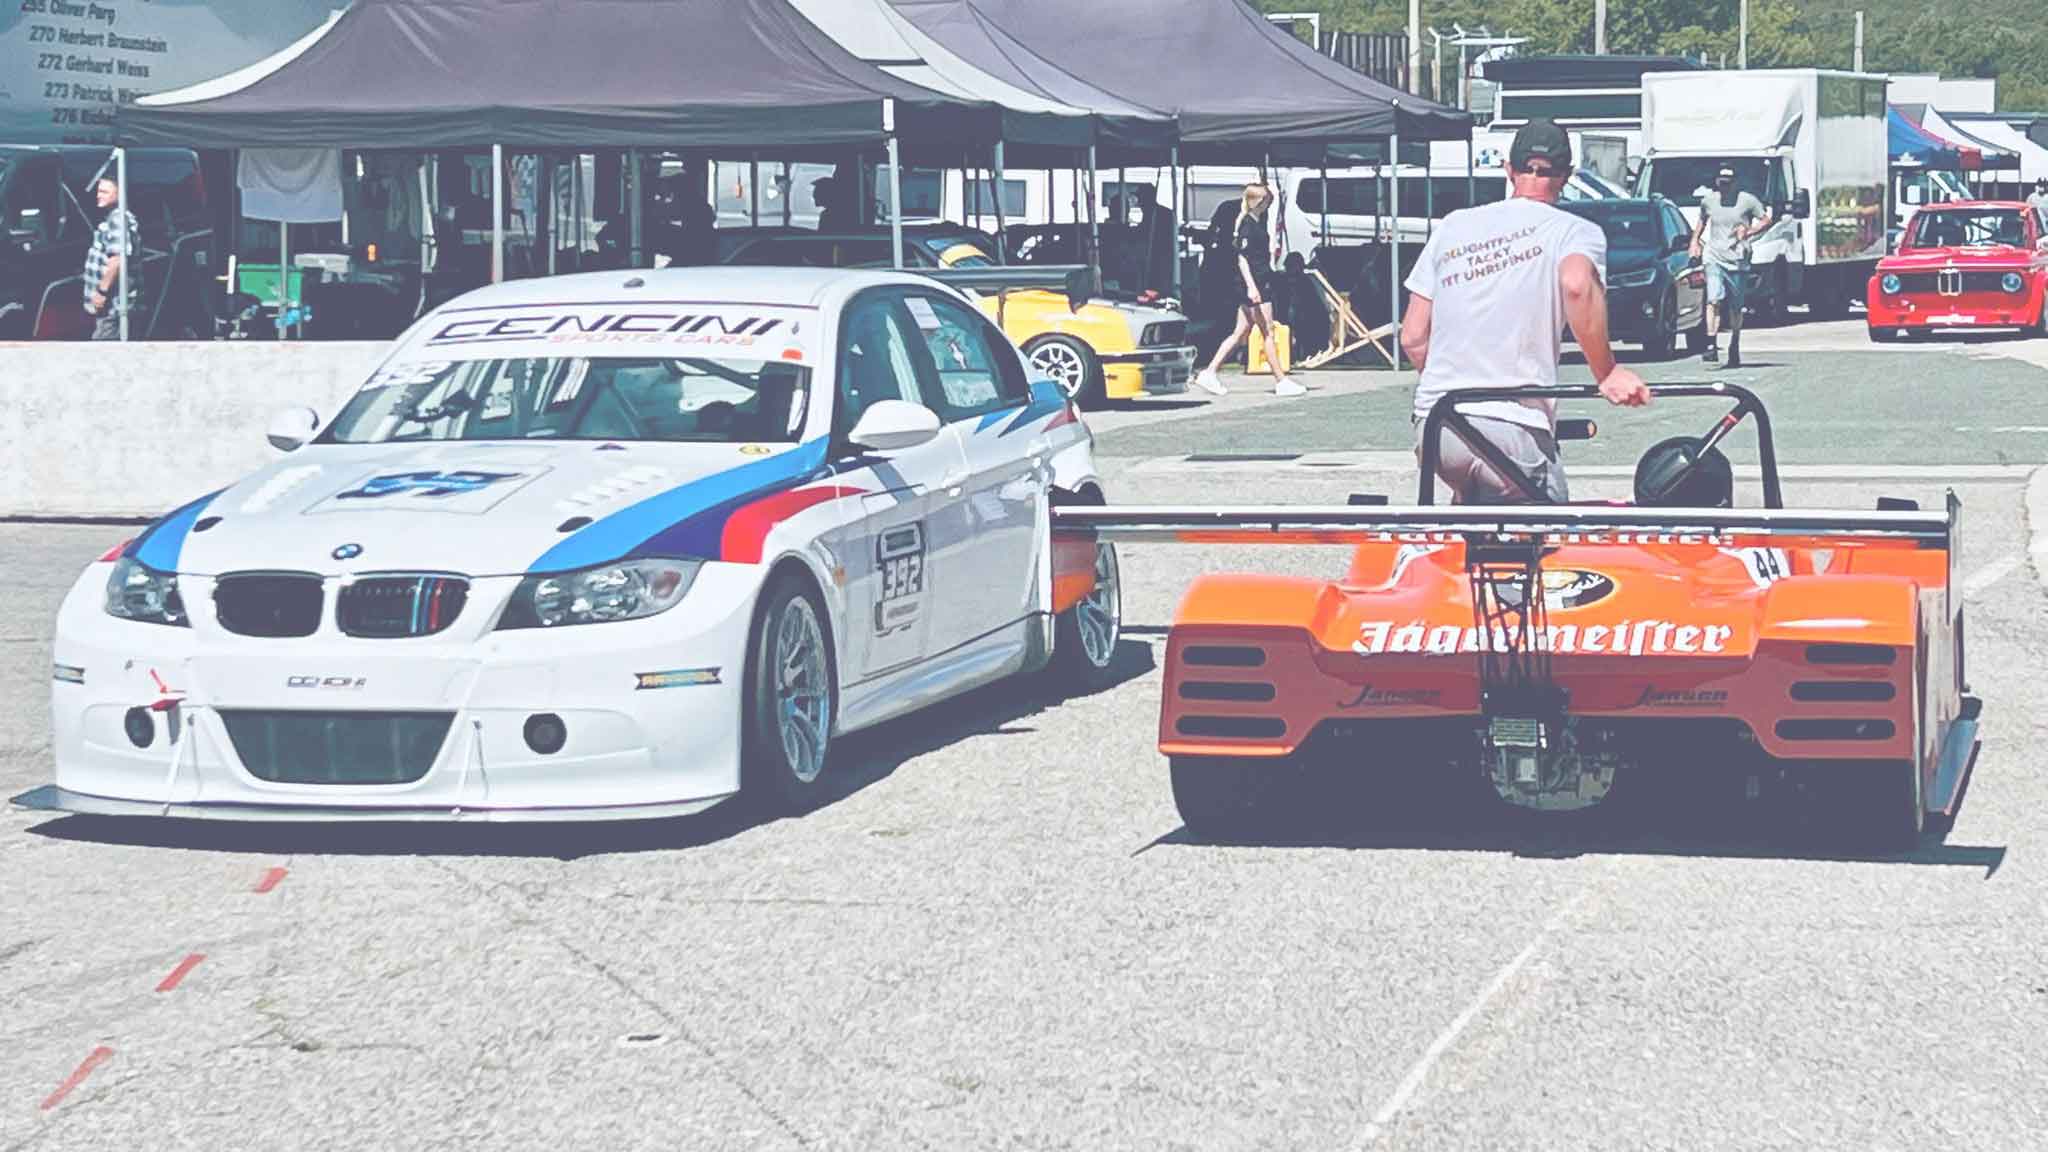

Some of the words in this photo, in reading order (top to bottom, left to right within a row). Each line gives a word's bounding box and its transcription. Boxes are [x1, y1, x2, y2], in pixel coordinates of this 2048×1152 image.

[29, 25, 56, 42] 270
[38, 53, 63, 71] 272
[44, 82, 69, 98] 273
[1463, 245, 1543, 281] UNREFINED
[1466, 246, 1511, 266] TACKY
[431, 314, 783, 341] CENCINI
